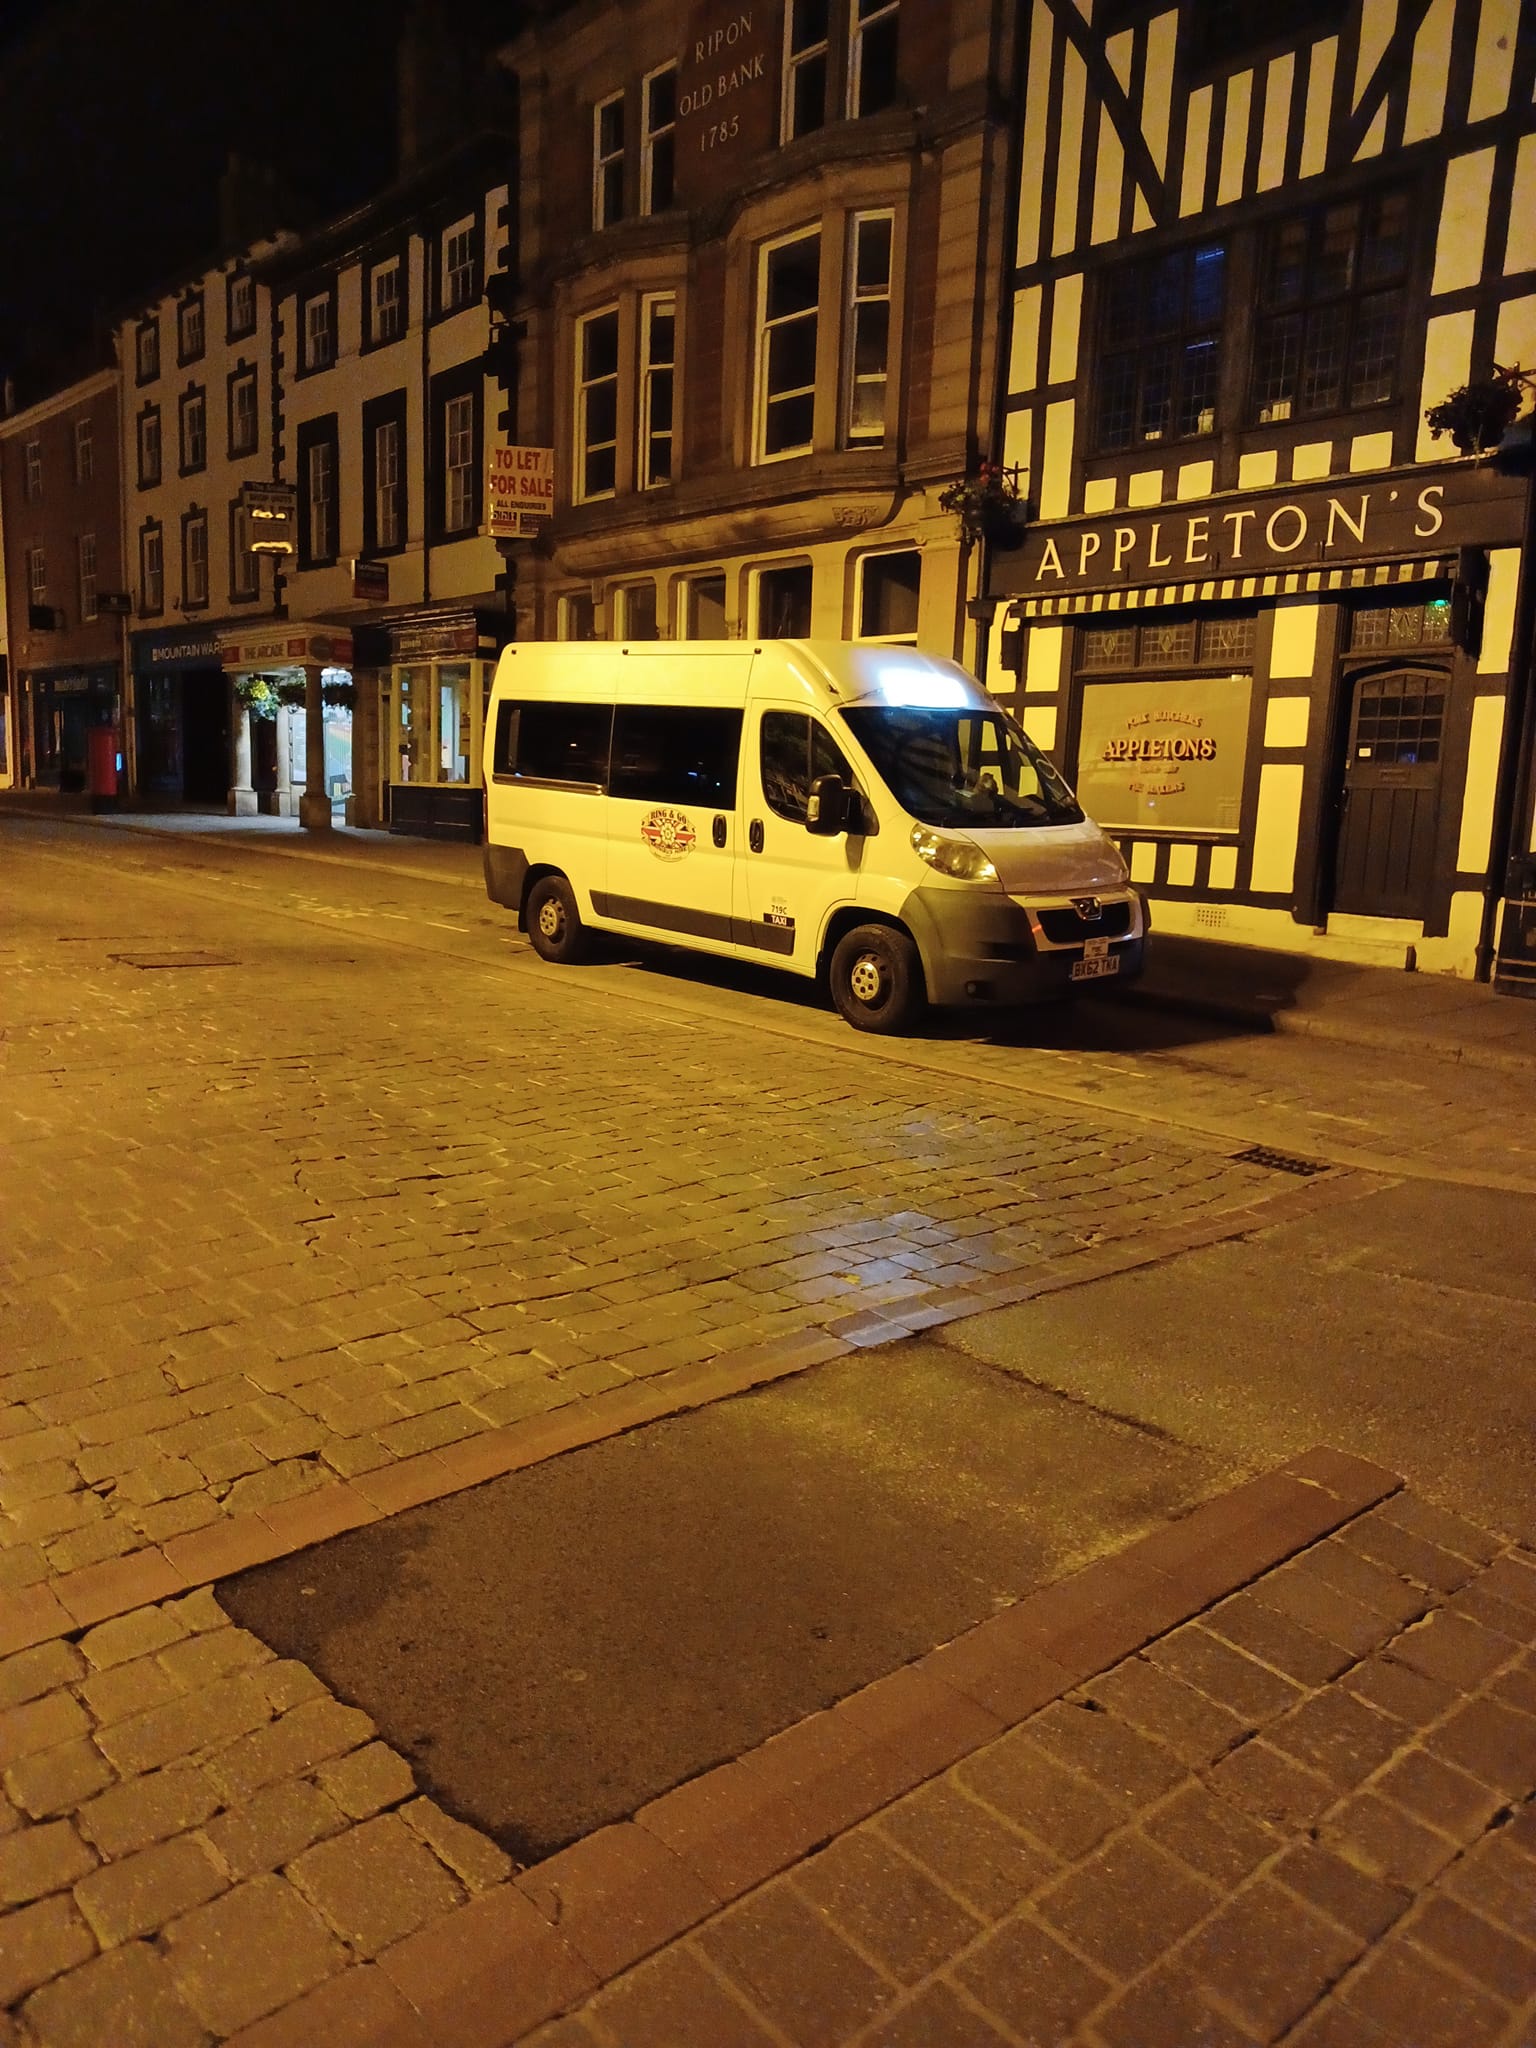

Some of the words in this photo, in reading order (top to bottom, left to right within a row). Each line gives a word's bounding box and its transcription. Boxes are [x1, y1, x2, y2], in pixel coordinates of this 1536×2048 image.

[695, 11, 754, 65] RIPON
[679, 83, 712, 118] OLD
[717, 54, 766, 98] BANK
[699, 115, 741, 153] 1785
[495, 449, 513, 469] TO
[517, 450, 541, 470] LET
[490, 475, 516, 495] FOR
[520, 476, 553, 498] SALE
[496, 499, 509, 508] ALL
[1034, 486, 1446, 582] APPLETON'S
[160, 643, 200, 661] MOUNTAIN
[1102, 737, 1217, 762] APPLETONS
[650, 809, 667, 820] RING
[669, 810, 675, 819] &
[676, 812, 687, 824] GO
[771, 915, 787, 926] TAXI
[1075, 960, 1099, 977] BX62
